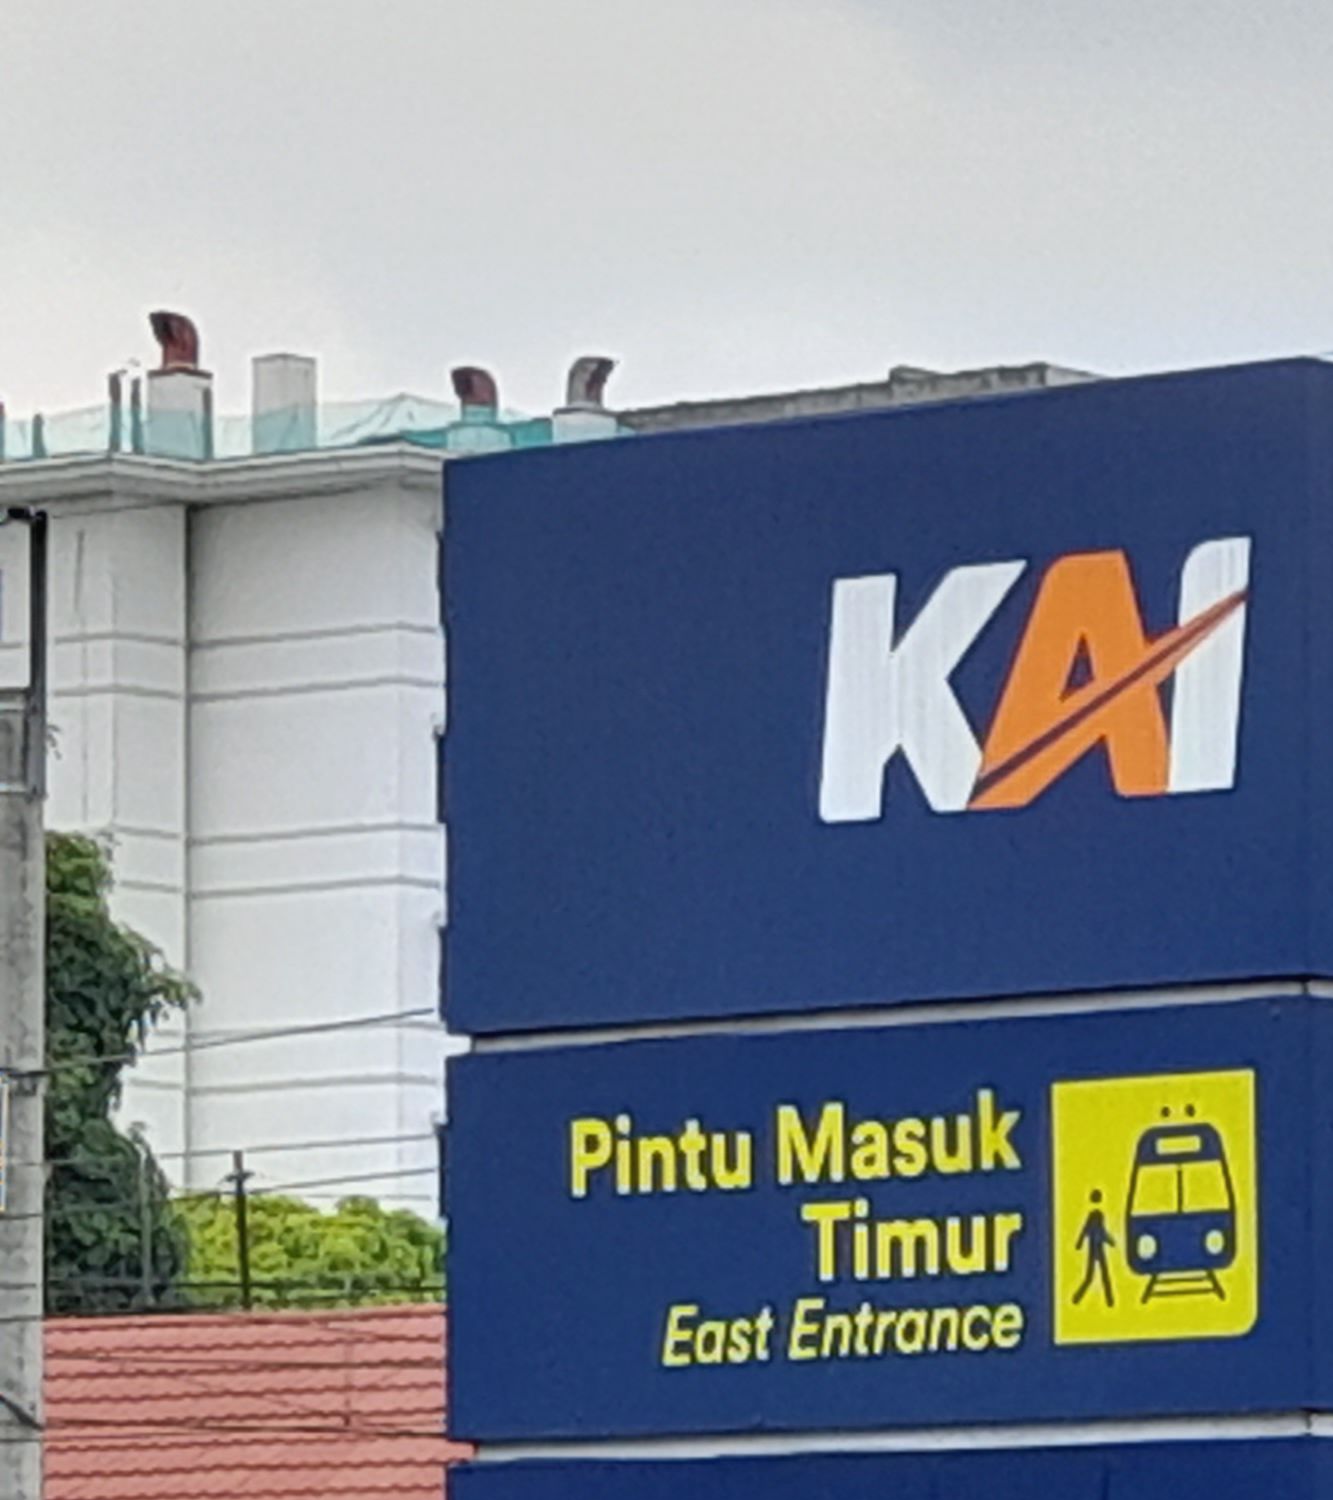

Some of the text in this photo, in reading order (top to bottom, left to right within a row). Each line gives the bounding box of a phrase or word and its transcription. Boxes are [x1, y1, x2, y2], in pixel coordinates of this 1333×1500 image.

[819, 537, 1252, 823] KAI
[569, 1090, 1022, 1197] Pintu Masuk
[802, 1199, 1022, 1283] Timur
[660, 1297, 1024, 1368] East Entrance
